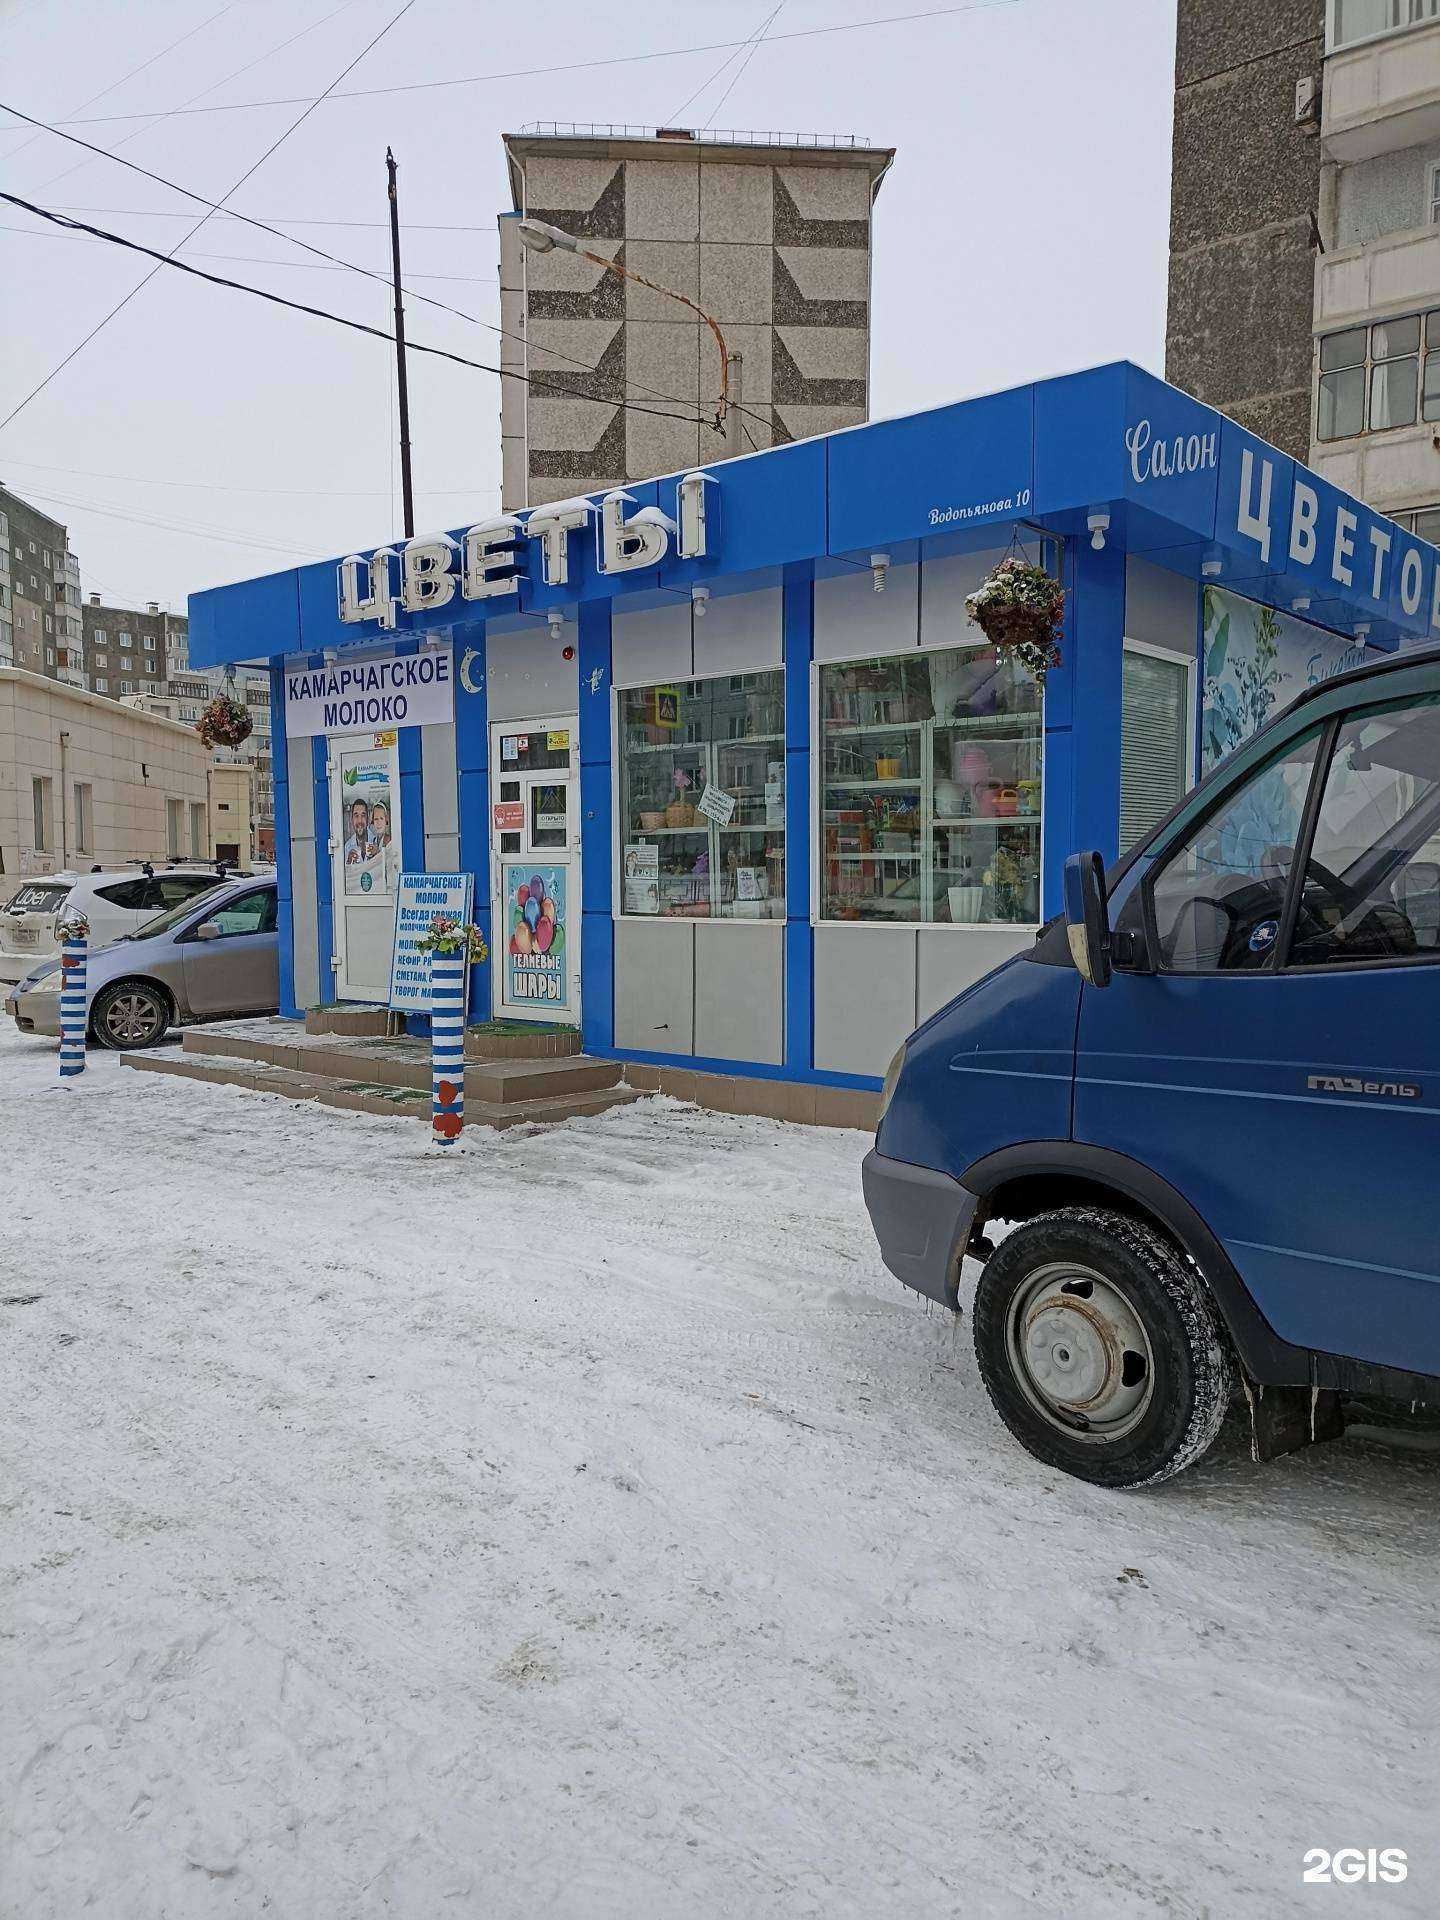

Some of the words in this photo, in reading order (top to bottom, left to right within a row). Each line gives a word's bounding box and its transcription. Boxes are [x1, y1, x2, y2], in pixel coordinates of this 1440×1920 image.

[1125, 419, 1218, 484] Салон
[928, 498, 1013, 525] Водопьянова
[1016, 489, 1031, 507] 10
[337, 476, 716, 630] ЦВЕТЫ
[289, 655, 449, 701] КАМАРЧАГСКОЕ
[324, 694, 408, 728] МОЛОКО
[403, 876, 462, 889] КАМАРЧАГСКОЕ
[415, 892, 448, 905] МОЛОКО
[401, 907, 429, 921] Всегда
[398, 955, 421, 966] КЕФИР
[395, 985, 419, 998] ТВОРОГ
[513, 972, 561, 1000] ШАРЫ
